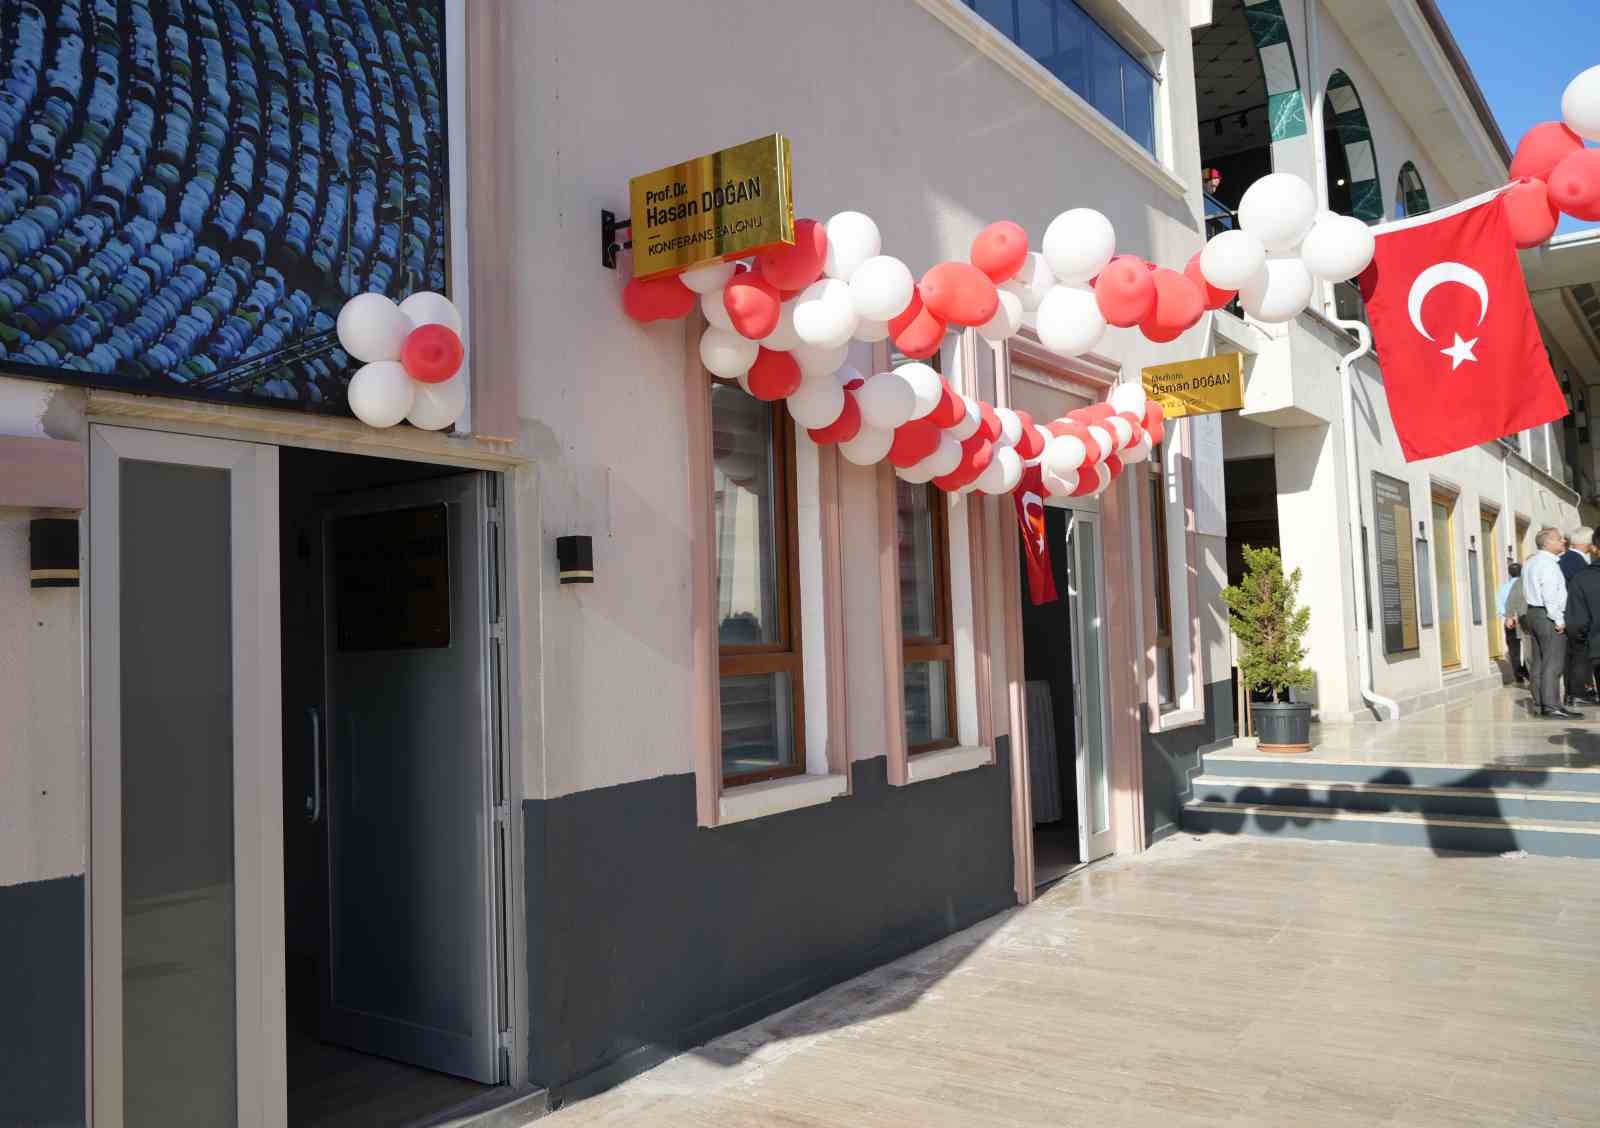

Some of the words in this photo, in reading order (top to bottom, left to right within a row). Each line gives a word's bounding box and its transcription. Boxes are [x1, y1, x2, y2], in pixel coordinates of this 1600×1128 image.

[647, 200, 698, 228] Hasan
[702, 176, 761, 213] DOĞAN
[648, 229, 714, 256] KONFERANS
[715, 215, 762, 238] SALONU
[1152, 382, 1190, 395] Osman
